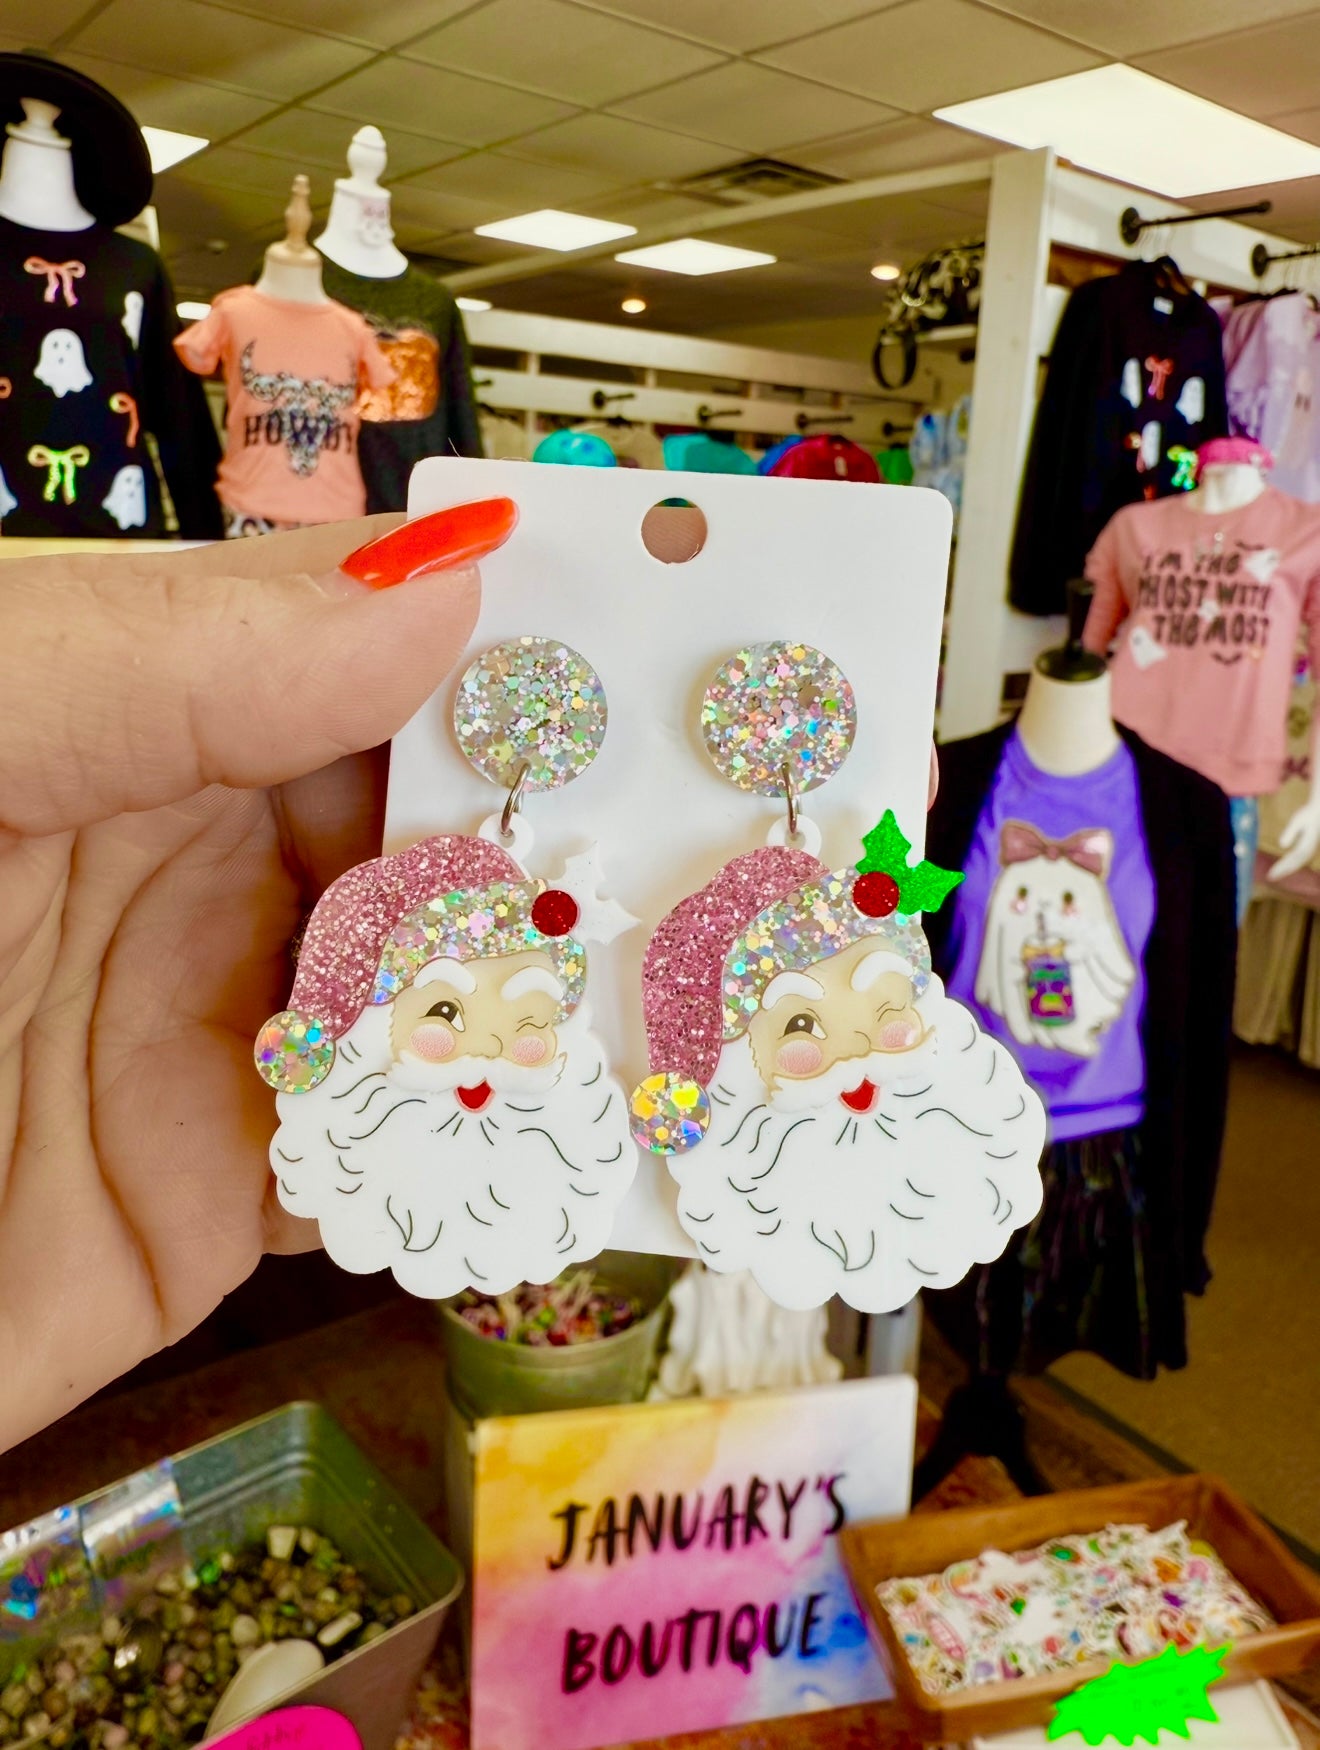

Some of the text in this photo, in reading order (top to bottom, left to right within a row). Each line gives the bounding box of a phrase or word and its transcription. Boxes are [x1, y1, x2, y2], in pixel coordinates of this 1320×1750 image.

[1154, 612, 1269, 648] THE MOST
[547, 1473, 847, 1571] JANUARY'S
[562, 1592, 828, 1694] BOUTIQUE
